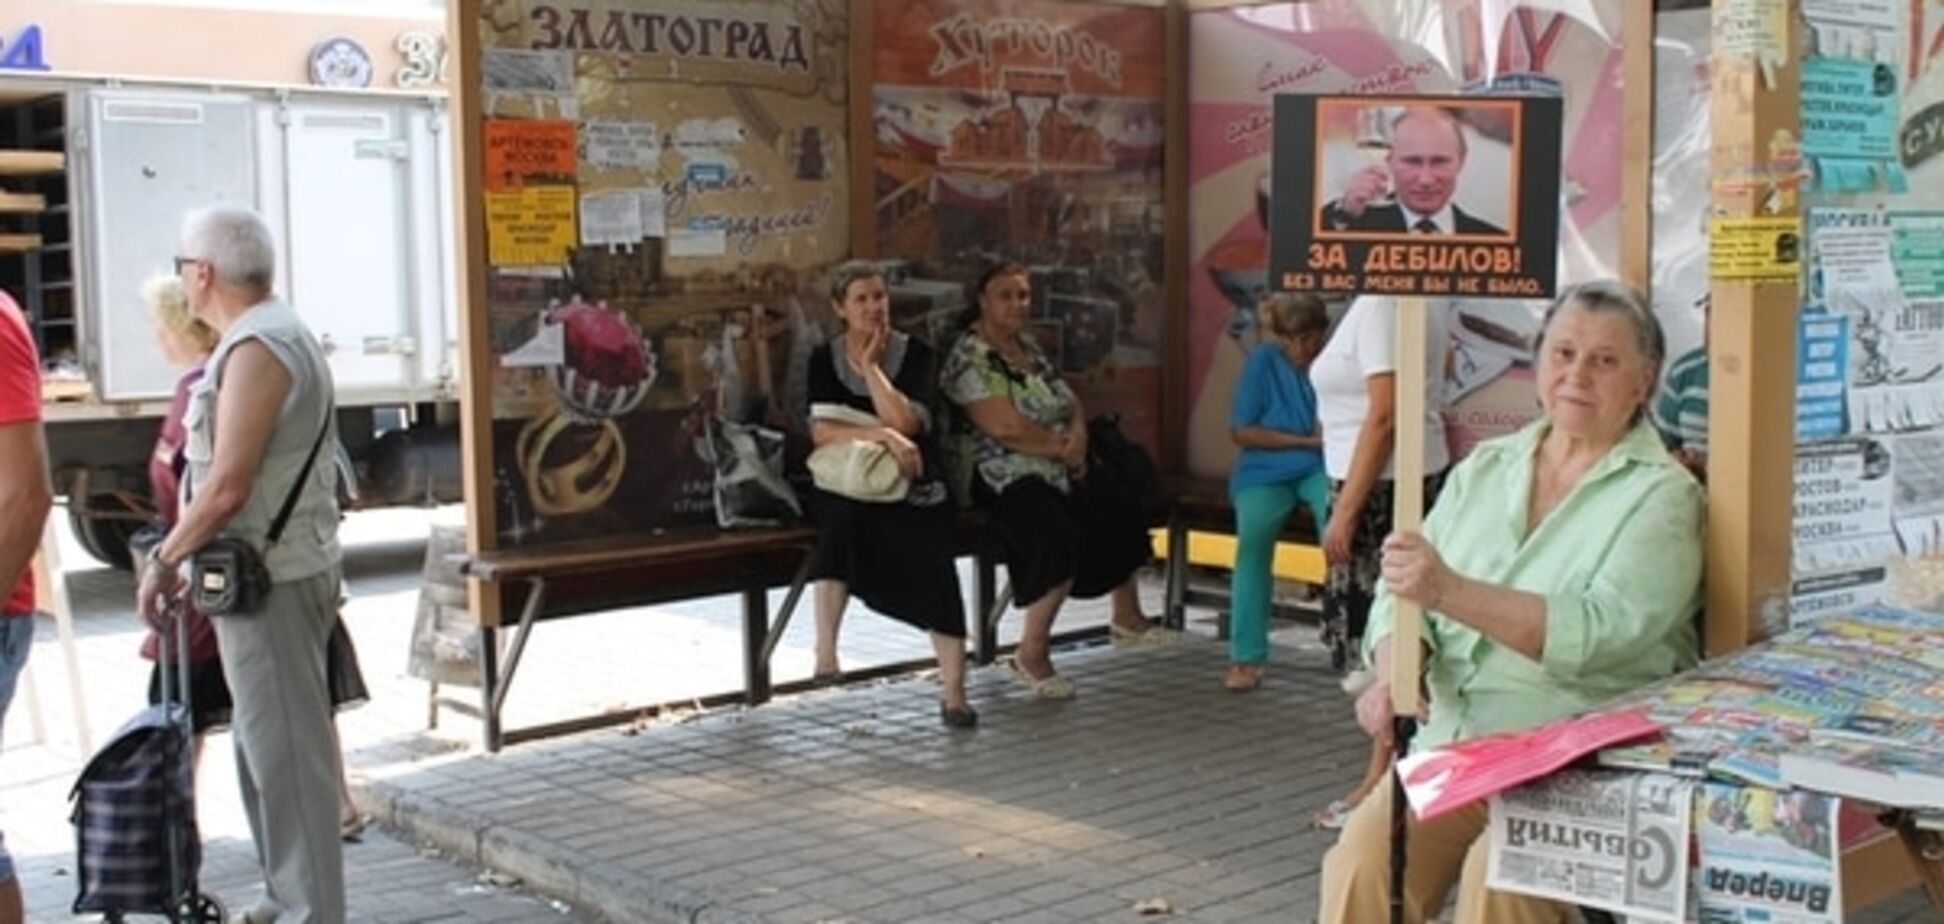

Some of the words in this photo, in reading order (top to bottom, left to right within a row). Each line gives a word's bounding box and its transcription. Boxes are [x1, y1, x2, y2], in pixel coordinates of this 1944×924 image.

[531, 7, 808, 68] ЗЛАТОГРАД
[395, 32, 450, 87] З
[1307, 243, 1347, 270] ЗА
[1363, 245, 1522, 273] ДЕБИЛОВ!
[1283, 273, 1315, 290] БЕЗ
[1322, 274, 1356, 290] ВАС
[1364, 275, 1415, 292] МЕНЯ
[1422, 277, 1450, 293] БЫ
[1458, 278, 1481, 293] НЕ
